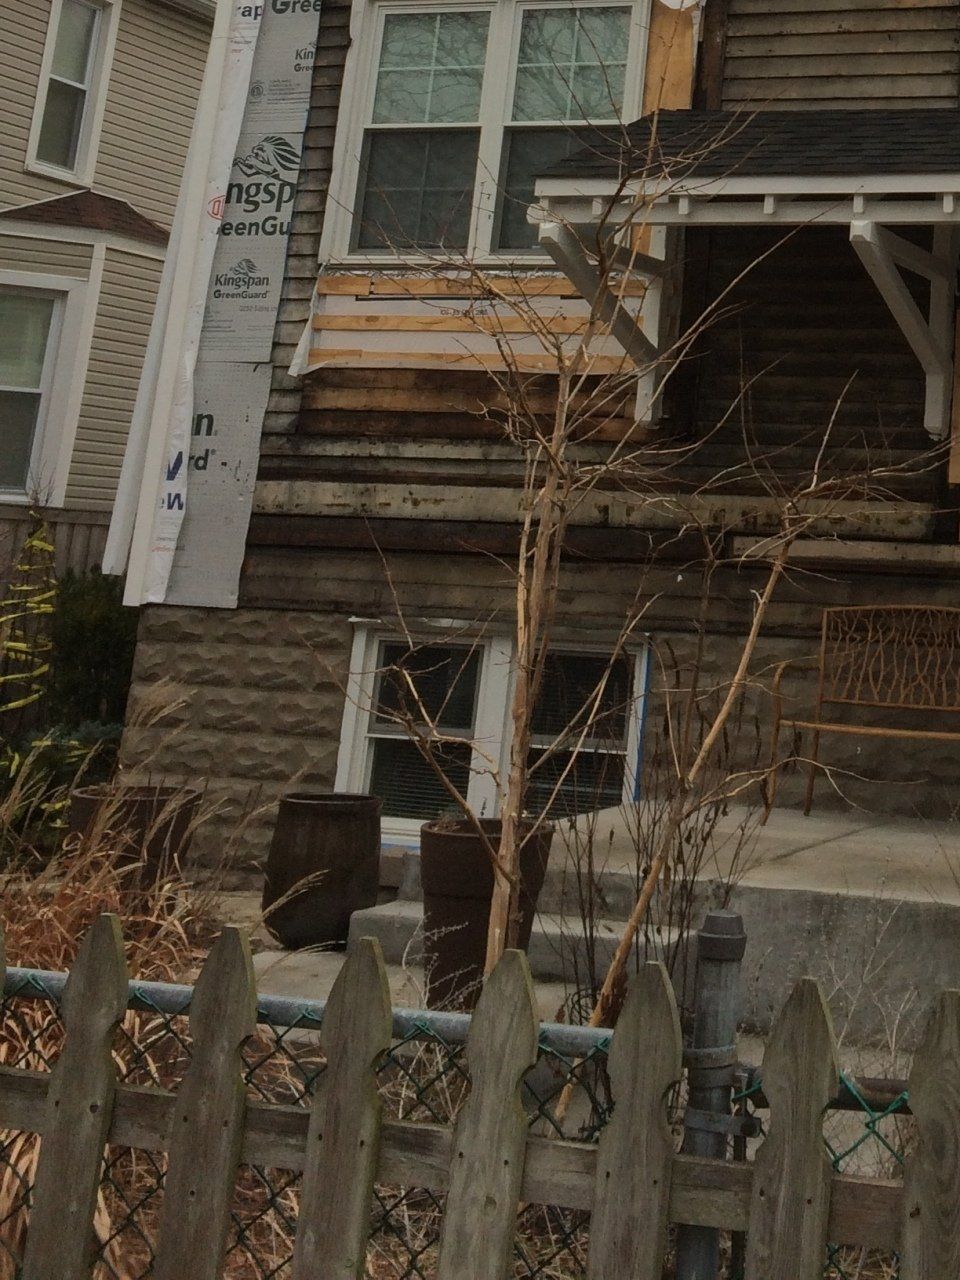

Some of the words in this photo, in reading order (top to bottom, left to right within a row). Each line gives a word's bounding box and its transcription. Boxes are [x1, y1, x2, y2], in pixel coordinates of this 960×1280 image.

[217, 215, 291, 236] eenGu
[214, 273, 270, 290] Kingspan
[213, 289, 269, 299] GreenGuard
